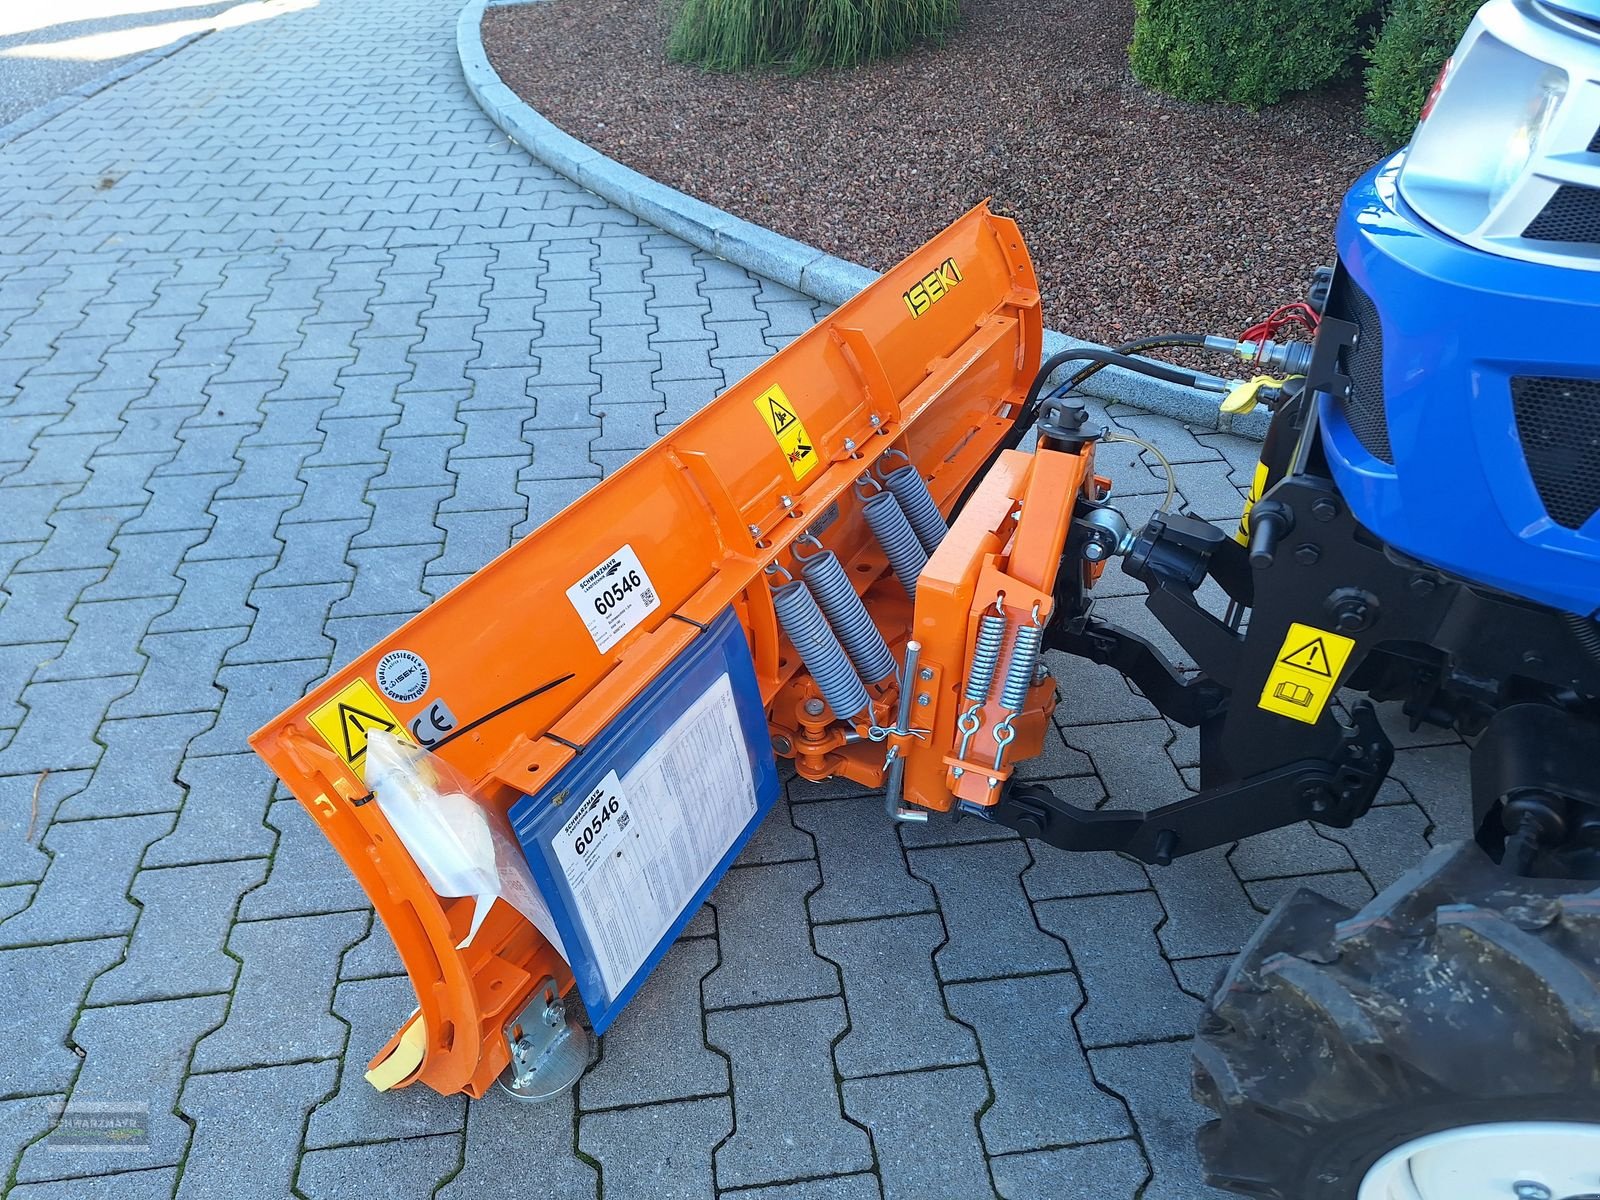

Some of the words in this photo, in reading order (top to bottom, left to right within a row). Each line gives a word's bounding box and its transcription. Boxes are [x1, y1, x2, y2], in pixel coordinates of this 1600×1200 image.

[902, 257, 963, 320] ISEKI
[580, 558, 616, 589] SCHWARZMAYR
[594, 570, 641, 615] 60546
[379, 652, 418, 685] QUALITÄTSSIEGEL
[395, 665, 418, 683] ISEKI
[564, 789, 600, 833] SCHWARZMAYR
[575, 796, 619, 855] 60546
